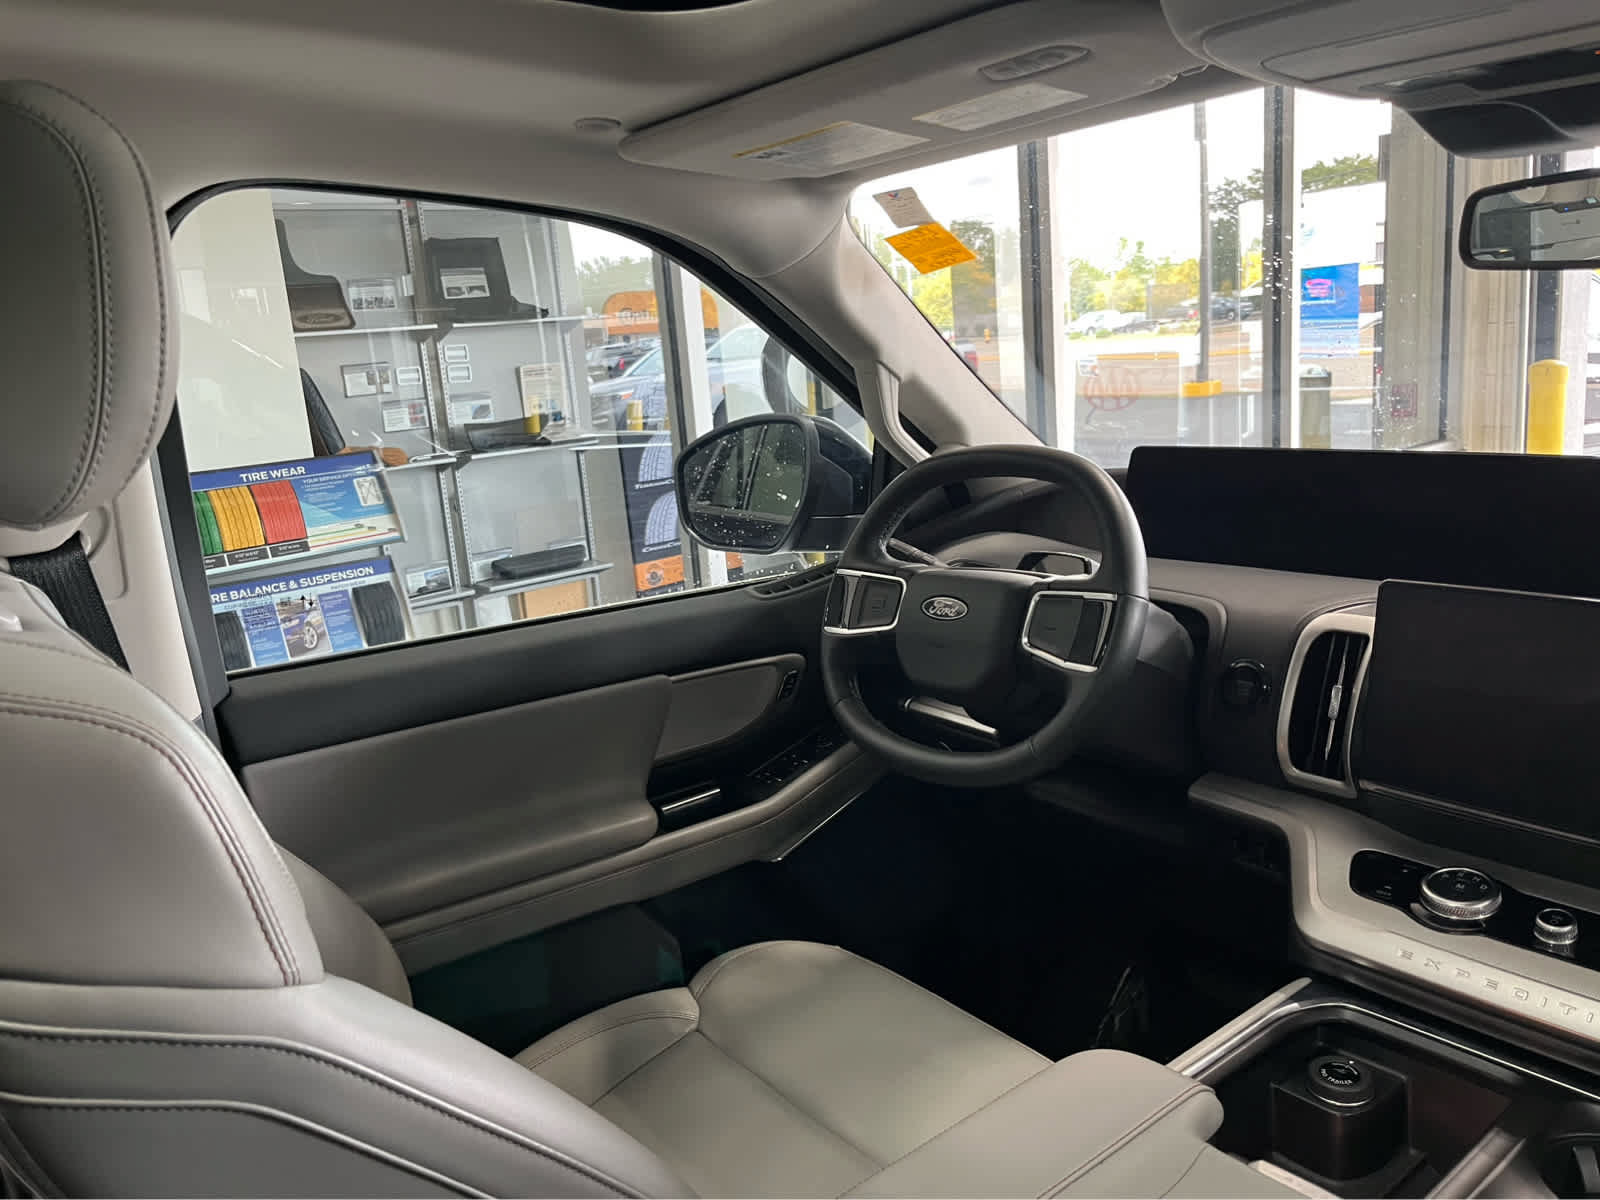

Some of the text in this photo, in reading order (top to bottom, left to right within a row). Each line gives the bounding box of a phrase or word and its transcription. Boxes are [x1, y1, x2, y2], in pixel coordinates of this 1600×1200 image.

[240, 466, 306, 483] TIRE WEAR
[230, 582, 288, 599] BALANCE
[288, 579, 298, 589] &
[299, 566, 374, 587] SUSPENSION
[928, 599, 960, 617] Ford
